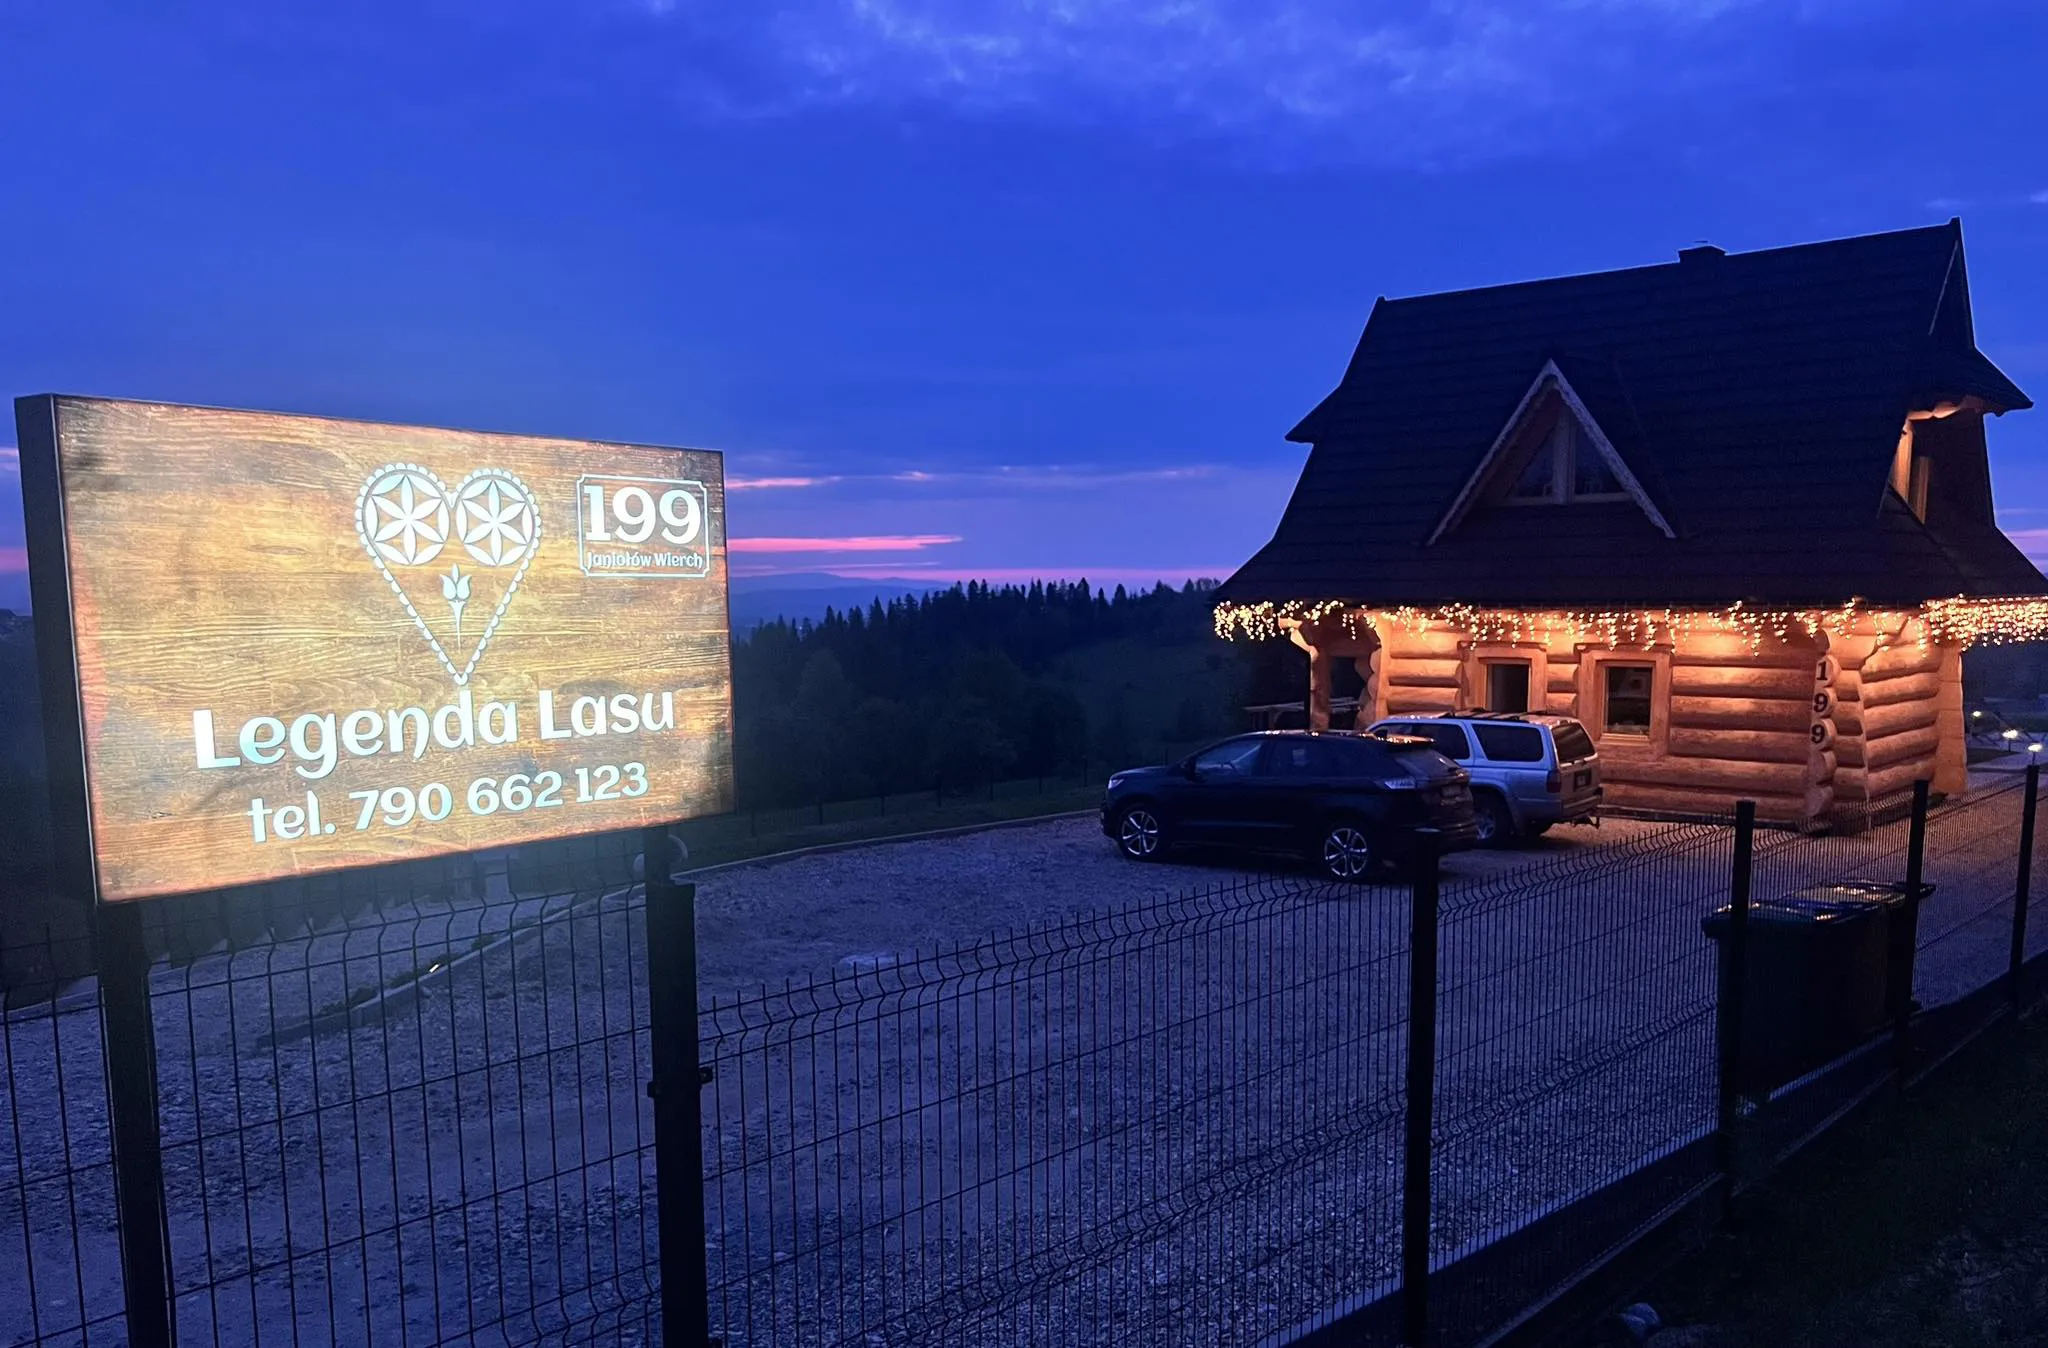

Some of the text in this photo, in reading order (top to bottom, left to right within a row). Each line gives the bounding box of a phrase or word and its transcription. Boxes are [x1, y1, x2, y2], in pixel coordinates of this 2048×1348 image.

[583, 485, 701, 544] 199
[654, 552, 703, 569] Wierch
[193, 690, 674, 779] Legenda Lasu
[248, 762, 648, 843] tel. 790 662 123
